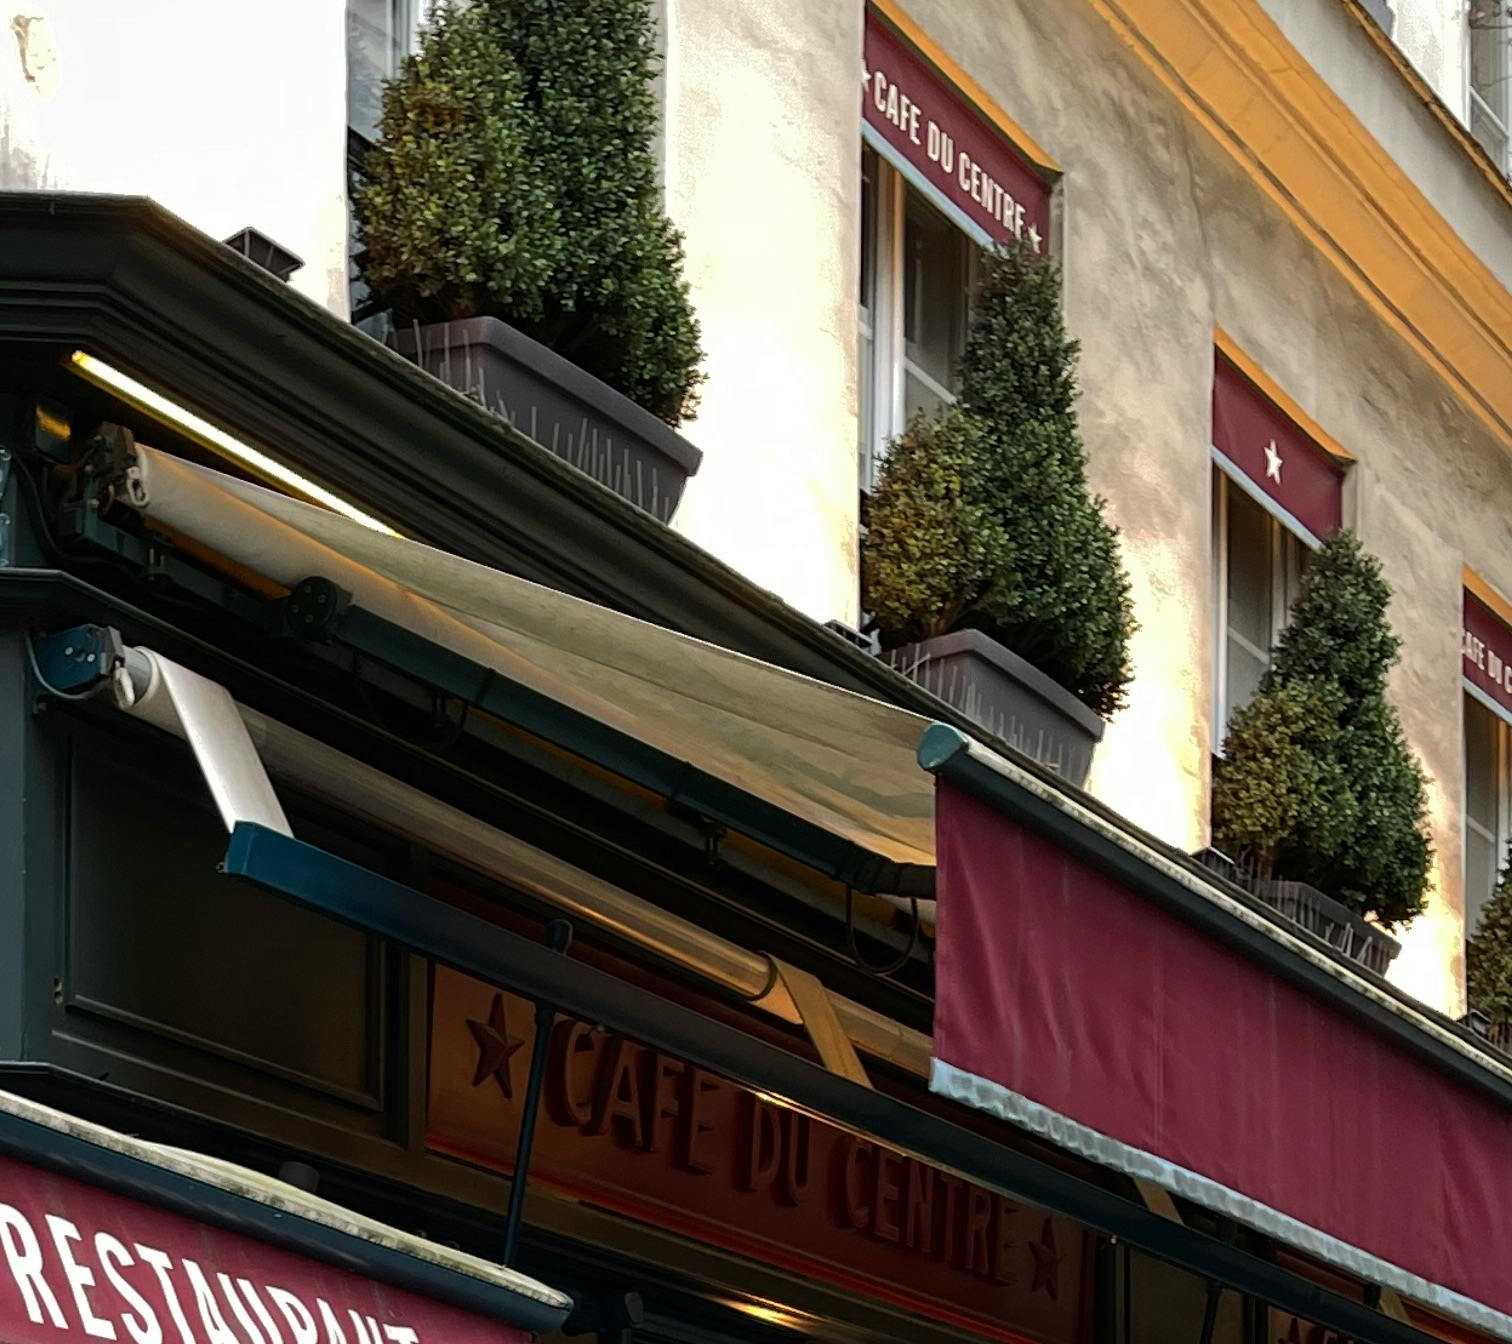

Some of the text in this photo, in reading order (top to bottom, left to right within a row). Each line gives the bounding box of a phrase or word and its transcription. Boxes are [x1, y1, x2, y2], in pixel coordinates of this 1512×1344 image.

[873, 71, 1026, 239] CAFE DU CENTRE
[549, 1019, 716, 1176] CAFE
[736, 1089, 811, 1206] DU
